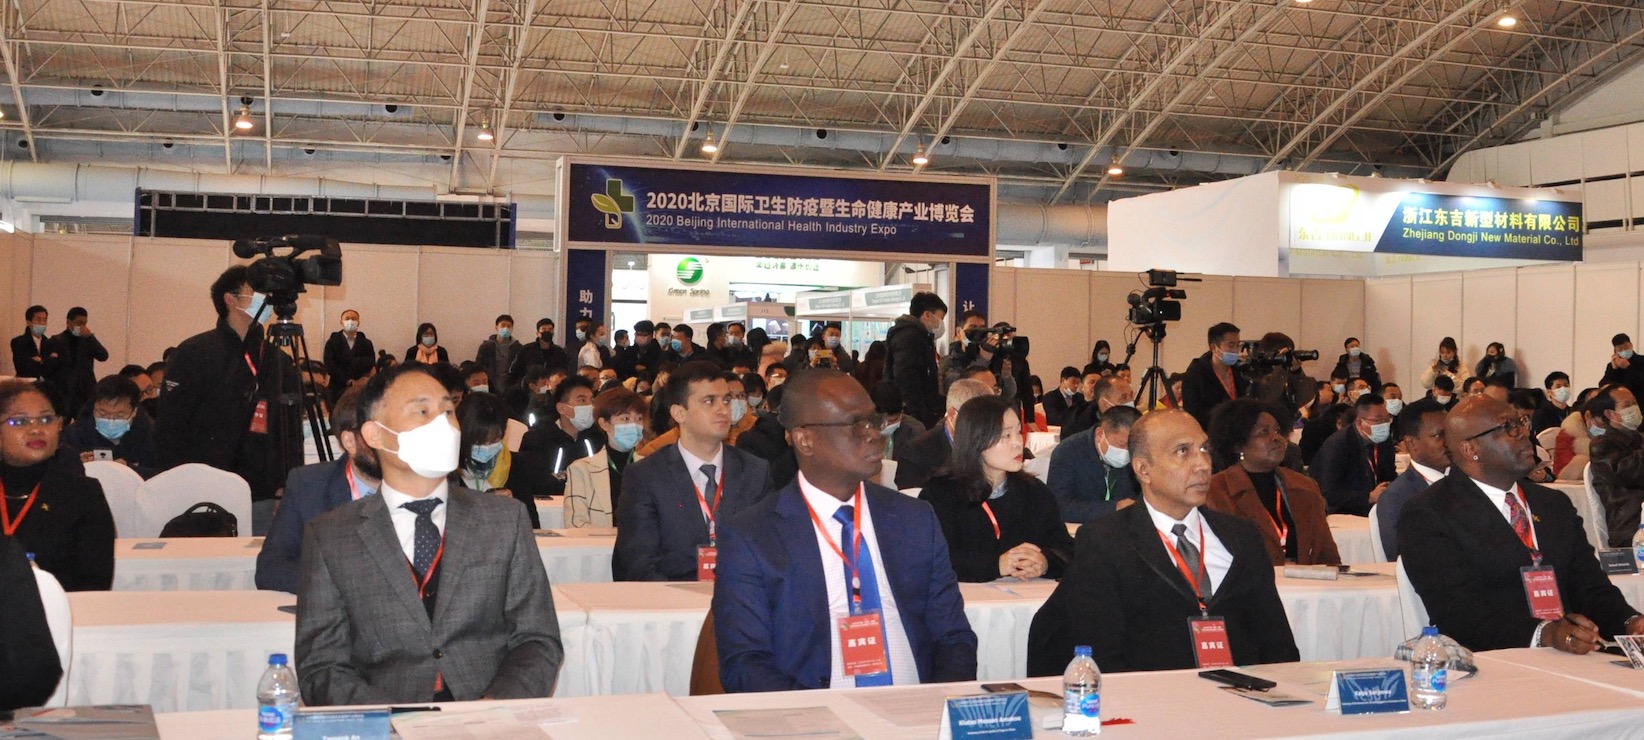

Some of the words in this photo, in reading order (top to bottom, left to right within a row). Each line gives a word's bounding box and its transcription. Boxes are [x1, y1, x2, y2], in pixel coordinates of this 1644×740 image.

[646, 192, 975, 223] 2020北京国际卫生防疫暨生命健康产业博览会
[1402, 206, 1581, 232] 浙江东吉新型材料有限公司
[646, 214, 673, 226] 2020
[677, 215, 714, 230] Beijing
[717, 217, 785, 231] International
[788, 221, 822, 232] Health
[826, 223, 867, 236] Industry
[871, 223, 897, 236] Expo
[1402, 227, 1445, 242] Zhejiang
[1448, 230, 1478, 244] Dongji
[1481, 232, 1501, 242] New
[1504, 233, 1541, 245] Material
[1543, 235, 1563, 246] Co.,
[1565, 235, 1580, 246] Ltd
[579, 289, 594, 319] 助力
[667, 287, 687, 297] Green
[690, 288, 711, 299] Spring
